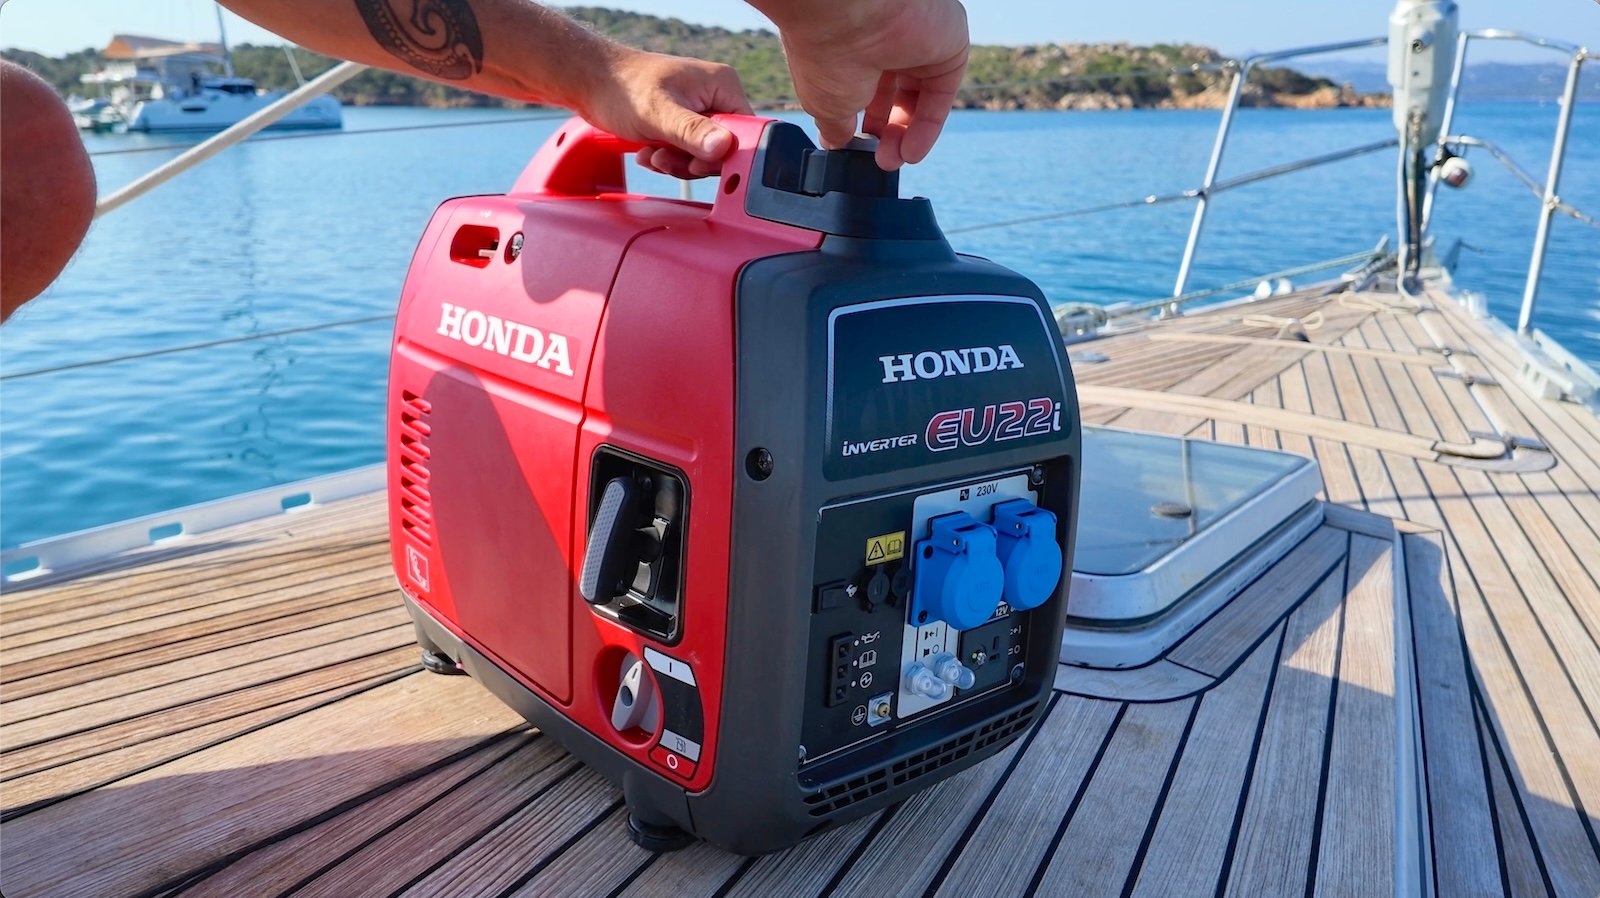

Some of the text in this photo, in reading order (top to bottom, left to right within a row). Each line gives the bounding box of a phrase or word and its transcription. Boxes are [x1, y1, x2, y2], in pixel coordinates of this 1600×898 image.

[436, 302, 574, 377] HONDA
[879, 344, 1025, 384] HONDA
[924, 397, 1062, 452] EU22i
[976, 482, 999, 497] 230V
